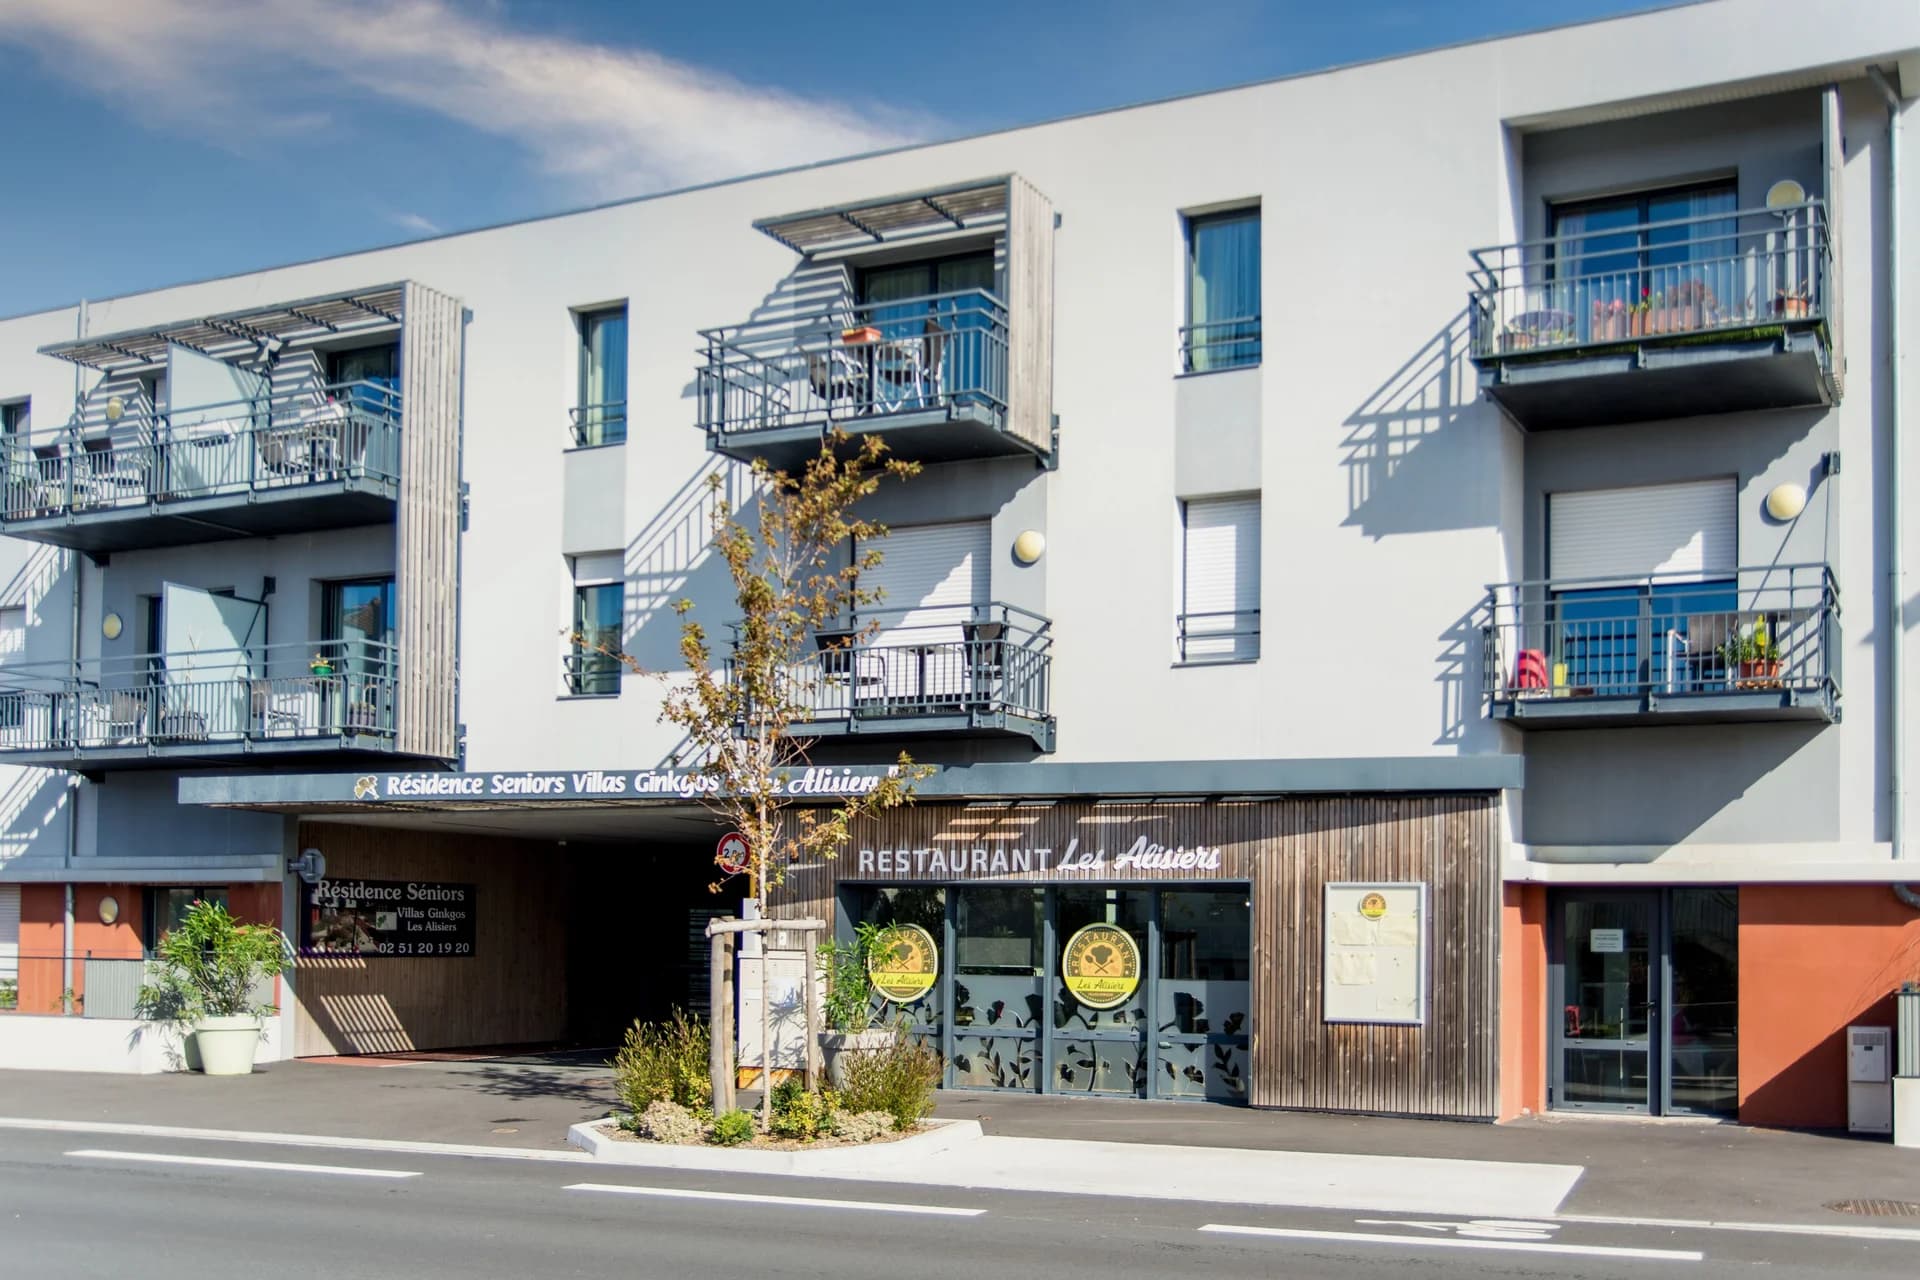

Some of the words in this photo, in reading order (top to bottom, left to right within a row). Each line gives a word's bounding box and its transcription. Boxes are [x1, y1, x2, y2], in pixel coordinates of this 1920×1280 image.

[387, 774, 483, 795] Résidence
[491, 773, 565, 794] Seniors
[572, 771, 626, 793] Villas
[634, 770, 719, 798] Ginkgos
[858, 848, 1052, 873] RESTAURANT
[1056, 838, 1106, 872] Les
[1114, 835, 1221, 871] Alisiers
[317, 880, 402, 900] Résidence
[407, 882, 465, 901] Séniors
[397, 907, 424, 918] Villas
[428, 908, 466, 921] Ginkgos
[407, 921, 422, 932] Les
[425, 921, 457, 932] Alisiers
[379, 943, 394, 953] 02
[398, 943, 413, 953] 51
[418, 943, 433, 953] 20
[438, 943, 452, 953] 19
[456, 943, 470, 953] 20
[1071, 932, 1132, 968] RESTAURANT
[1077, 978, 1091, 990] Les
